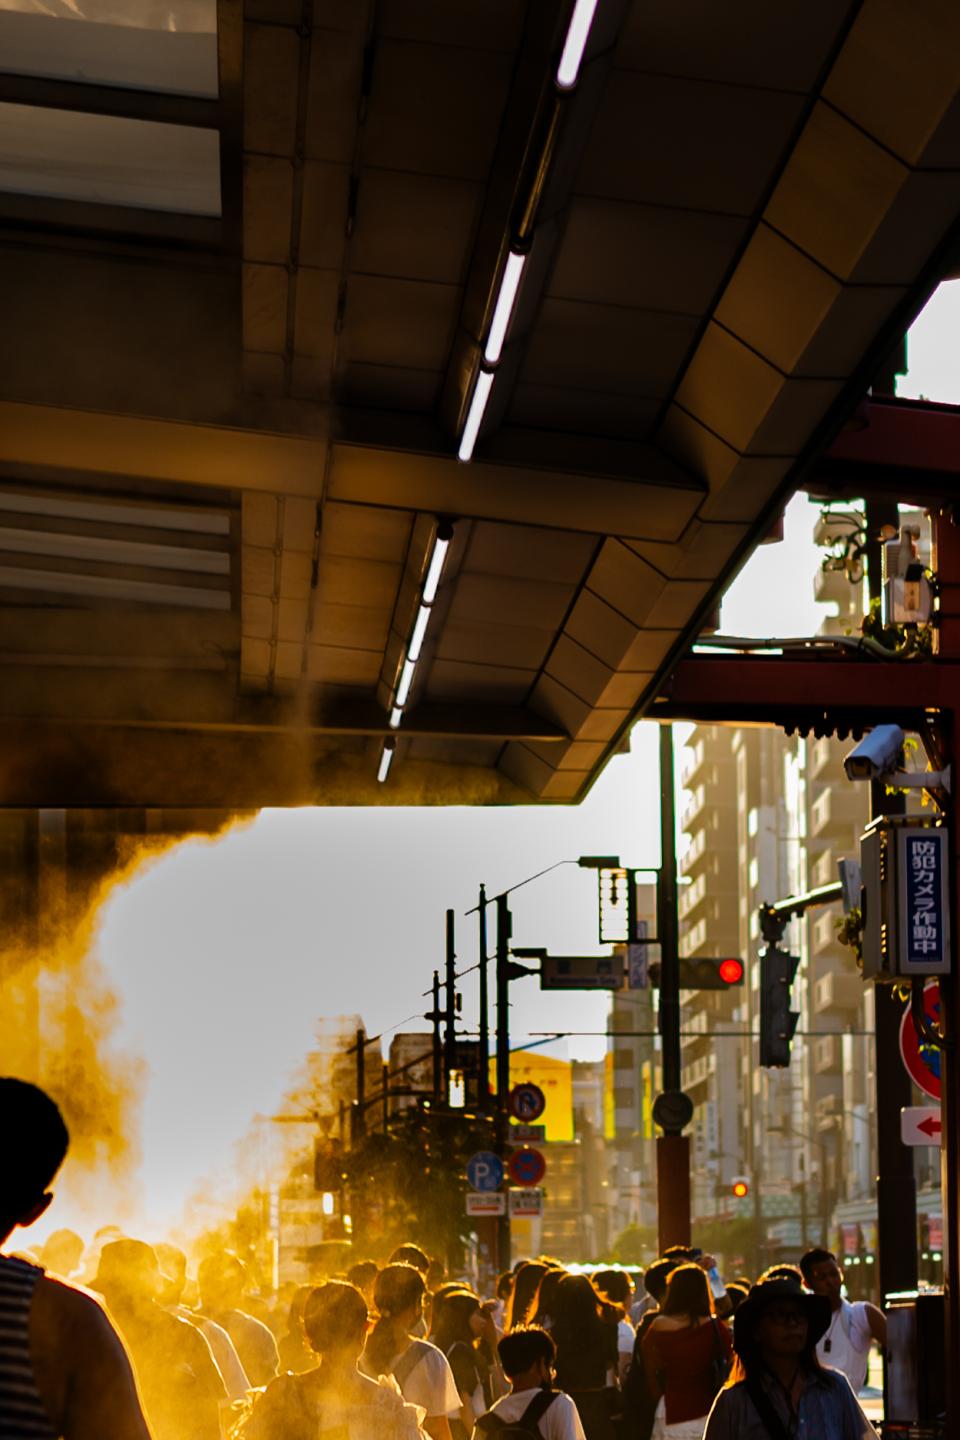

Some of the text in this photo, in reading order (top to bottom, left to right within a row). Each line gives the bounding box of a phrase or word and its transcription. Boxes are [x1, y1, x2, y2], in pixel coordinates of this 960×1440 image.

[911, 841, 938, 955] 防犯カメラ作動中
